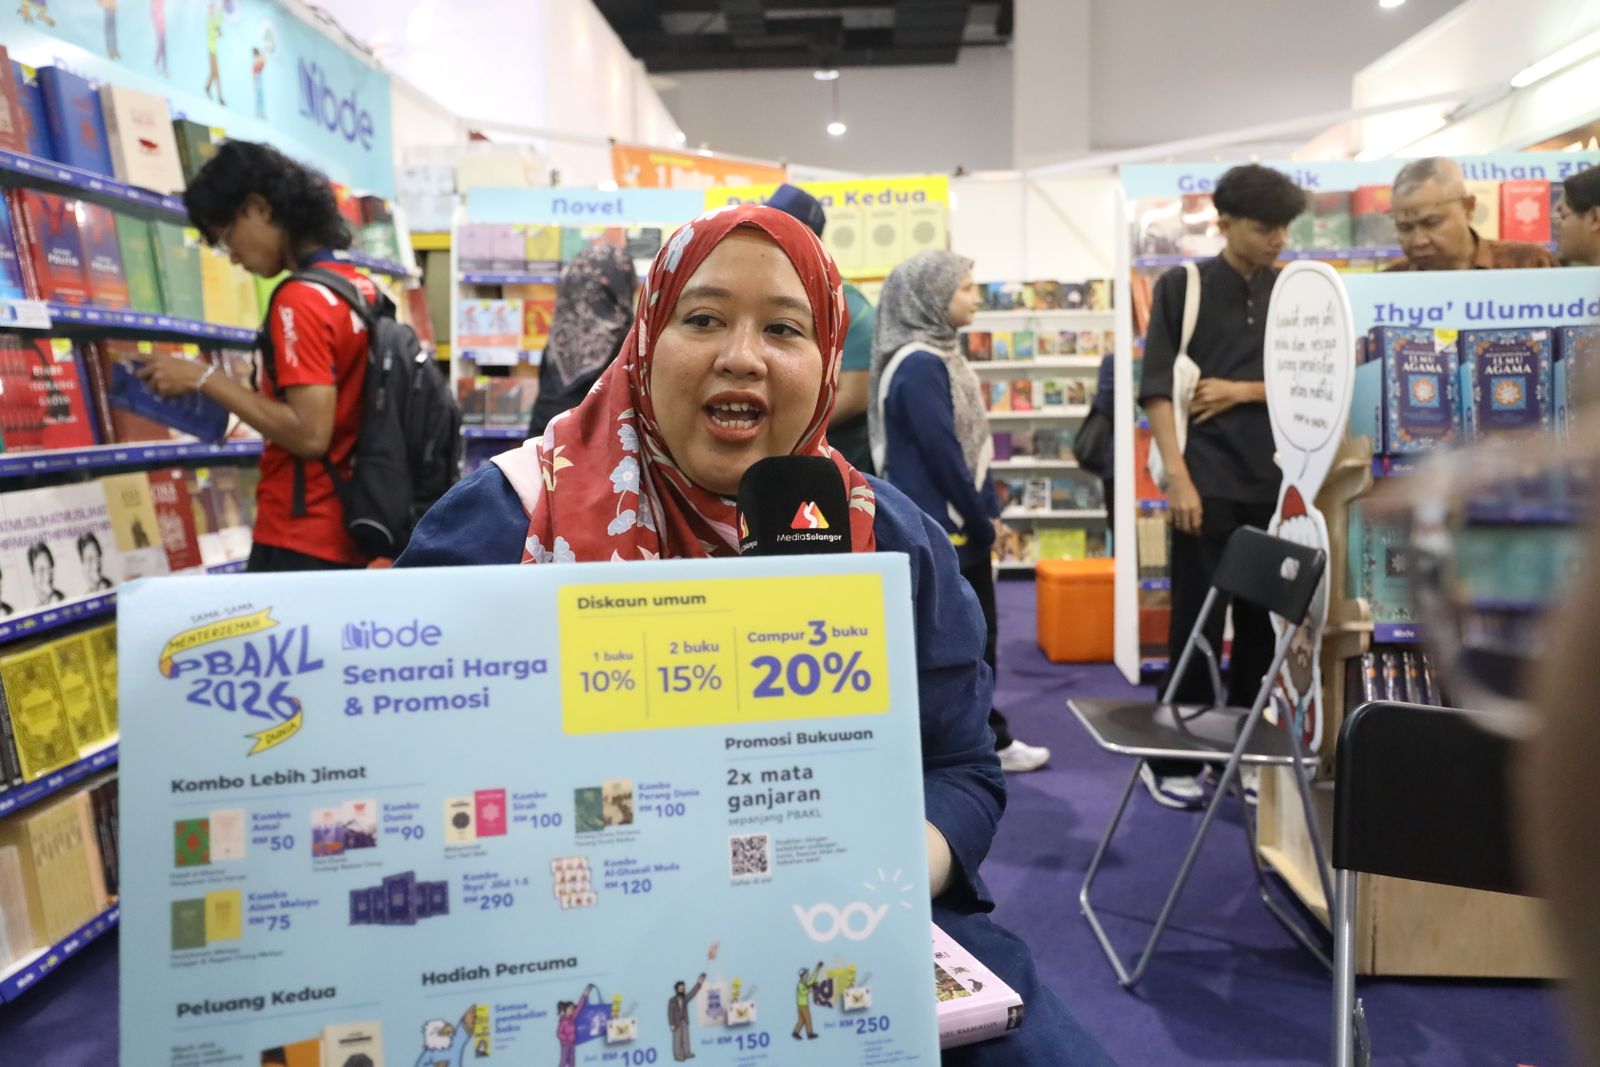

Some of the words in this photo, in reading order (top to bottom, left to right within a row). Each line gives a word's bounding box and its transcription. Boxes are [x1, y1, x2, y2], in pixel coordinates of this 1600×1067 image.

[1462, 160, 1545, 179] ilihan
[551, 196, 624, 216] Novel
[844, 188, 926, 207] Kedua
[1374, 301, 1453, 327] Ihya'
[1402, 363, 1443, 373] AGAMA
[1485, 364, 1531, 374] AGAMA
[577, 594, 648, 610] Diskaun
[653, 592, 707, 607] umum
[747, 630, 806, 646] Campur
[807, 620, 827, 647] 3
[832, 625, 868, 638] buku
[169, 624, 324, 679] PBAKL
[593, 652, 599, 662] 1
[603, 651, 634, 661] buku
[669, 642, 679, 654] 2
[683, 640, 720, 654] buku
[343, 656, 454, 685] Senarai
[463, 658, 548, 680] Harga
[657, 664, 722, 693] 15%
[749, 651, 872, 699] 20%
[580, 669, 636, 693] 10%
[186, 678, 302, 722] 2026
[343, 698, 364, 717] &
[373, 687, 490, 715] Promosi
[725, 731, 792, 751] Promosi
[796, 728, 874, 746] Bukuwan
[171, 777, 245, 794] Kombo
[251, 769, 305, 787] Lebih
[311, 766, 366, 784] Jimat
[726, 768, 752, 786] 2x
[760, 764, 814, 783] mata
[638, 781, 671, 791] Kombo
[727, 787, 821, 813] ganjaran
[655, 803, 685, 818] 100
[728, 812, 784, 827] sepanjang
[786, 807, 822, 820] PBAKL
[530, 813, 562, 829] 100
[401, 825, 424, 840] 90
[270, 835, 294, 851] 50
[604, 857, 637, 867] Kombo
[621, 879, 652, 895] 120
[480, 893, 514, 910] 290
[266, 914, 291, 931] 75
[421, 965, 490, 987] Hadiah
[495, 956, 578, 978] Percuma
[176, 993, 266, 1018] Peluang
[271, 985, 337, 1005] Kedua
[856, 1015, 890, 1034] 250
[735, 1031, 770, 1051] 150
[621, 1047, 657, 1067] 100
